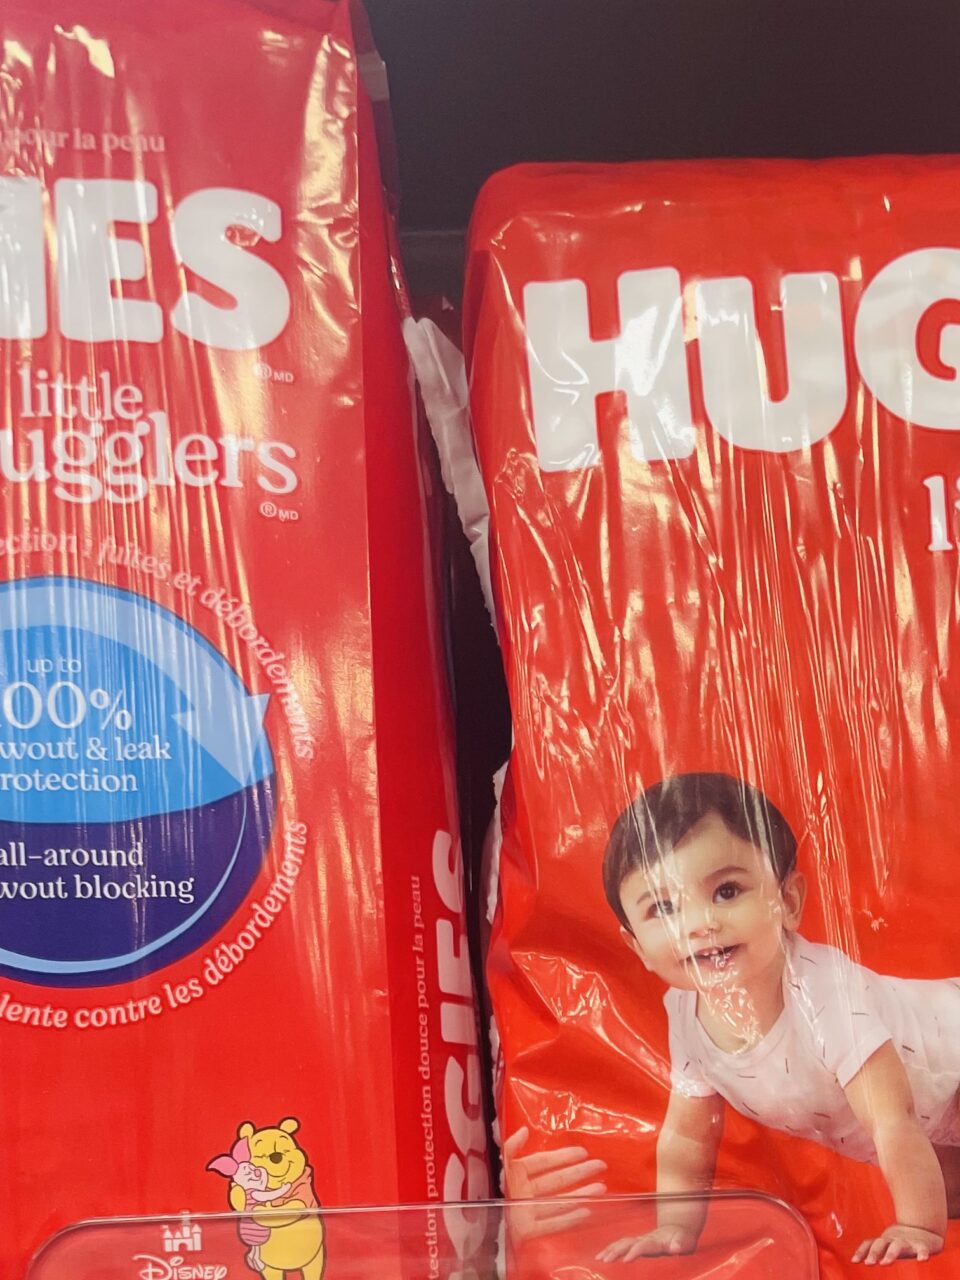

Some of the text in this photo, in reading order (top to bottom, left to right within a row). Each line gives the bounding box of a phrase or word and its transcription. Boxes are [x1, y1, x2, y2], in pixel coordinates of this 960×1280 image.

[73, 127, 97, 150] la
[18, 366, 144, 420] little
[173, 571, 204, 597] et
[26, 656, 82, 678] up to
[0, 681, 133, 731] 00%
[86, 736, 109, 762] &
[114, 734, 172, 762] leak
[75, 874, 195, 905] blocking
[410, 875, 425, 931] peau
[73, 821, 308, 1029] contre les débordements
[411, 933, 425, 954] la
[414, 957, 430, 1009] pour
[417, 1018, 431, 1081] douce
[420, 1083, 439, 1200] protection
